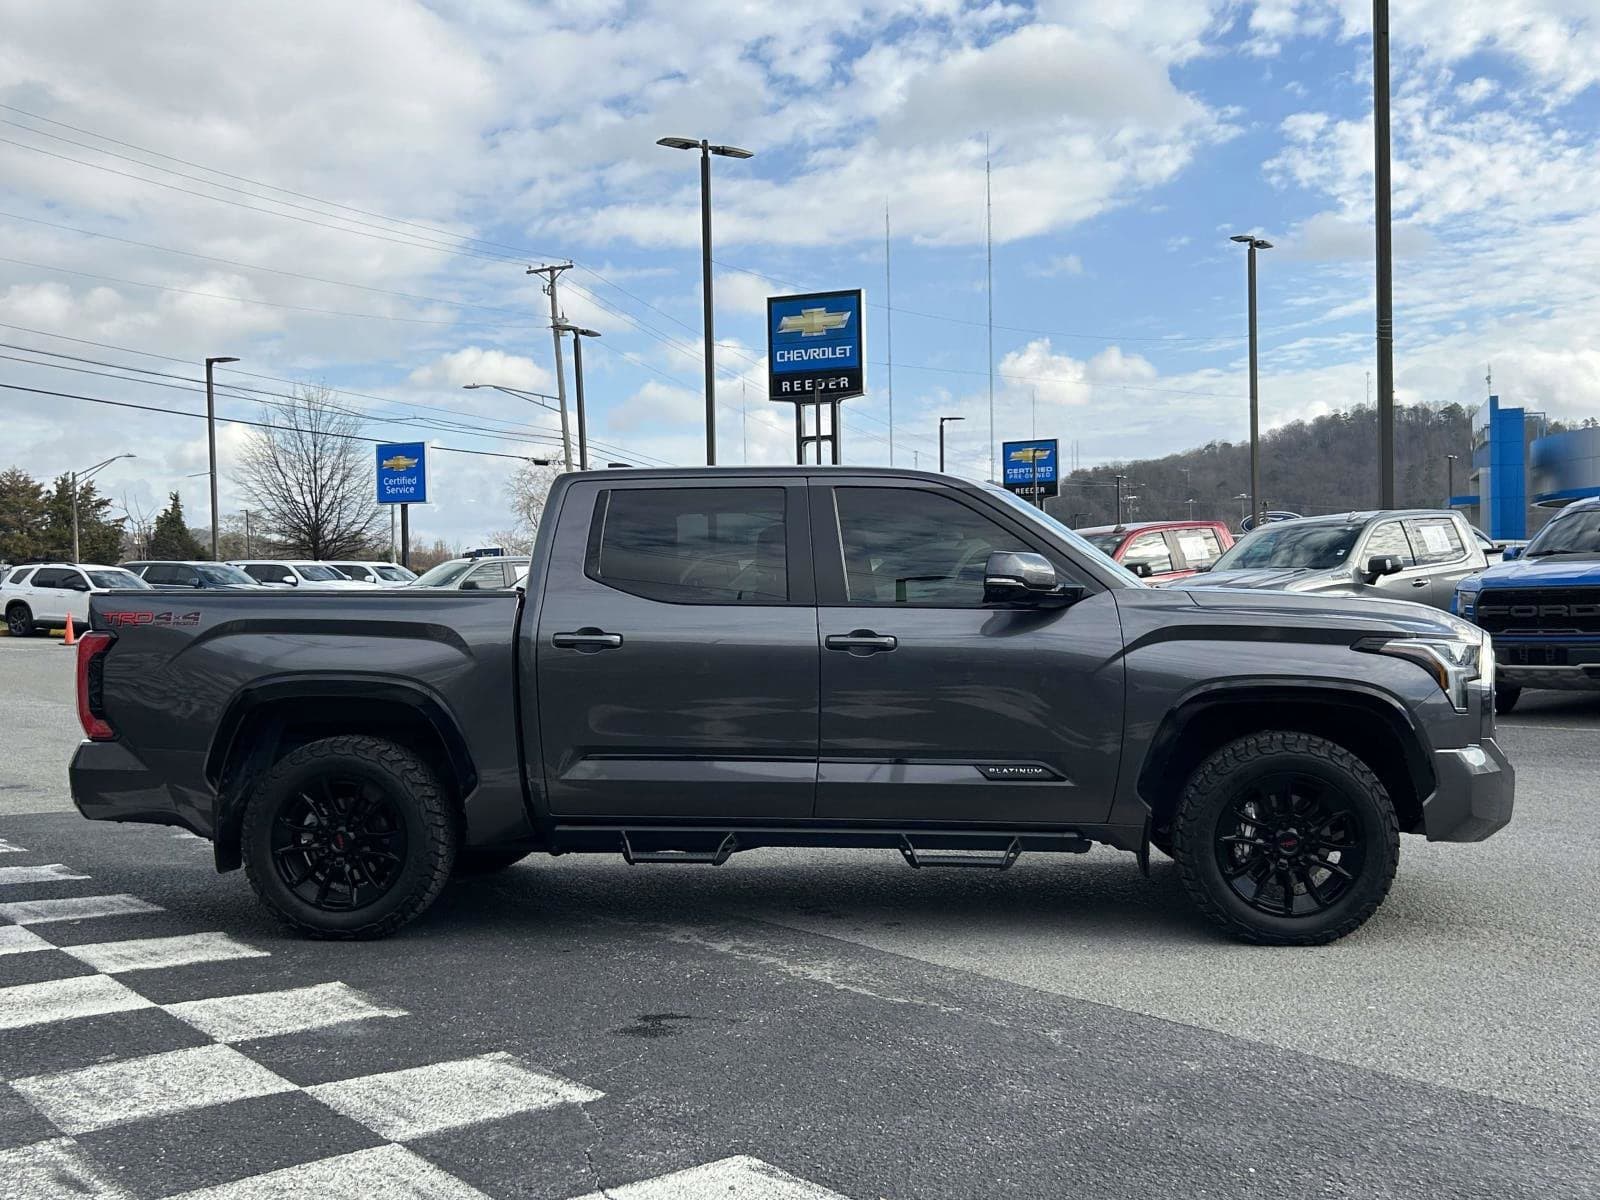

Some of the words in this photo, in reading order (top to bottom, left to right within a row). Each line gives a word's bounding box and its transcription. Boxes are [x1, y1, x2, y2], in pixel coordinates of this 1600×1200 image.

[776, 345, 853, 362] CHEVROLET
[1007, 467, 1053, 475] CERTIIED
[383, 476, 417, 486] Certified
[385, 485, 415, 494] Service
[1478, 605, 1600, 617] FORD
[103, 611, 153, 627] TRD
